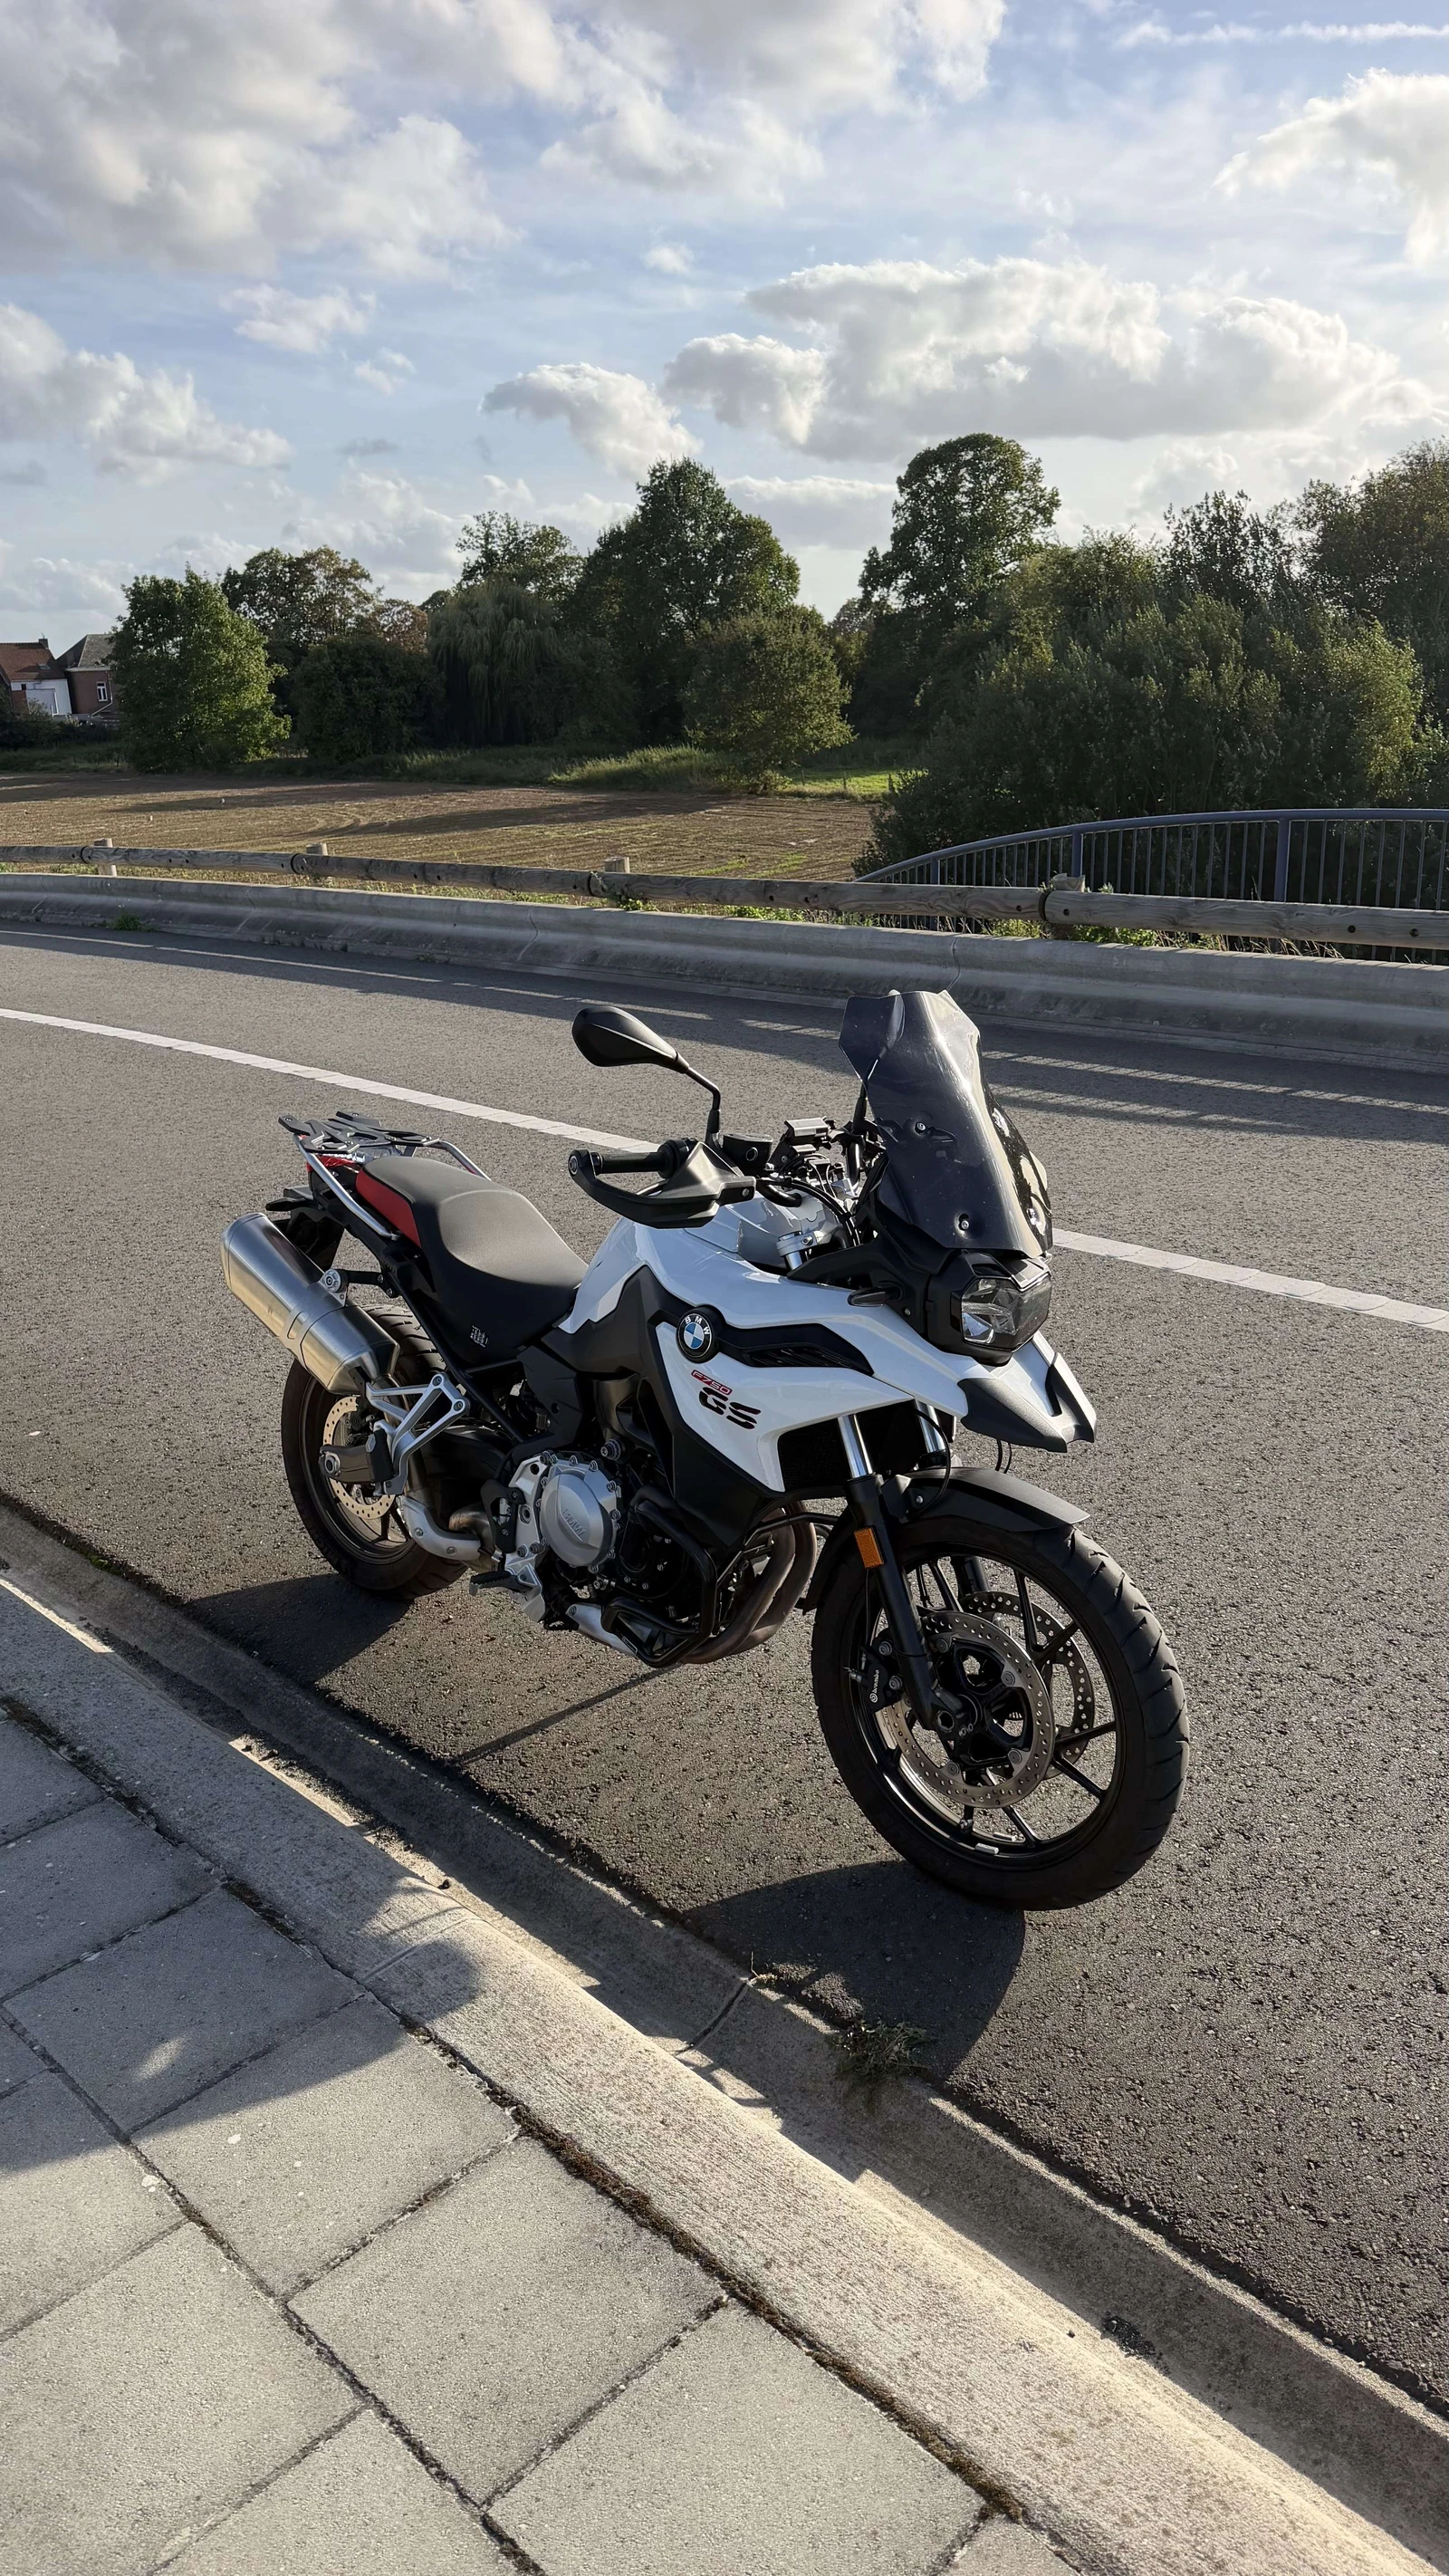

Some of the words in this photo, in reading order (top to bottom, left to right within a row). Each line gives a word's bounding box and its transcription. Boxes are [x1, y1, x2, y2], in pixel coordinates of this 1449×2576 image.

[685, 1315, 711, 1335] BMW
[698, 1387, 762, 1429] GS
[562, 1507, 586, 1537] BMW
